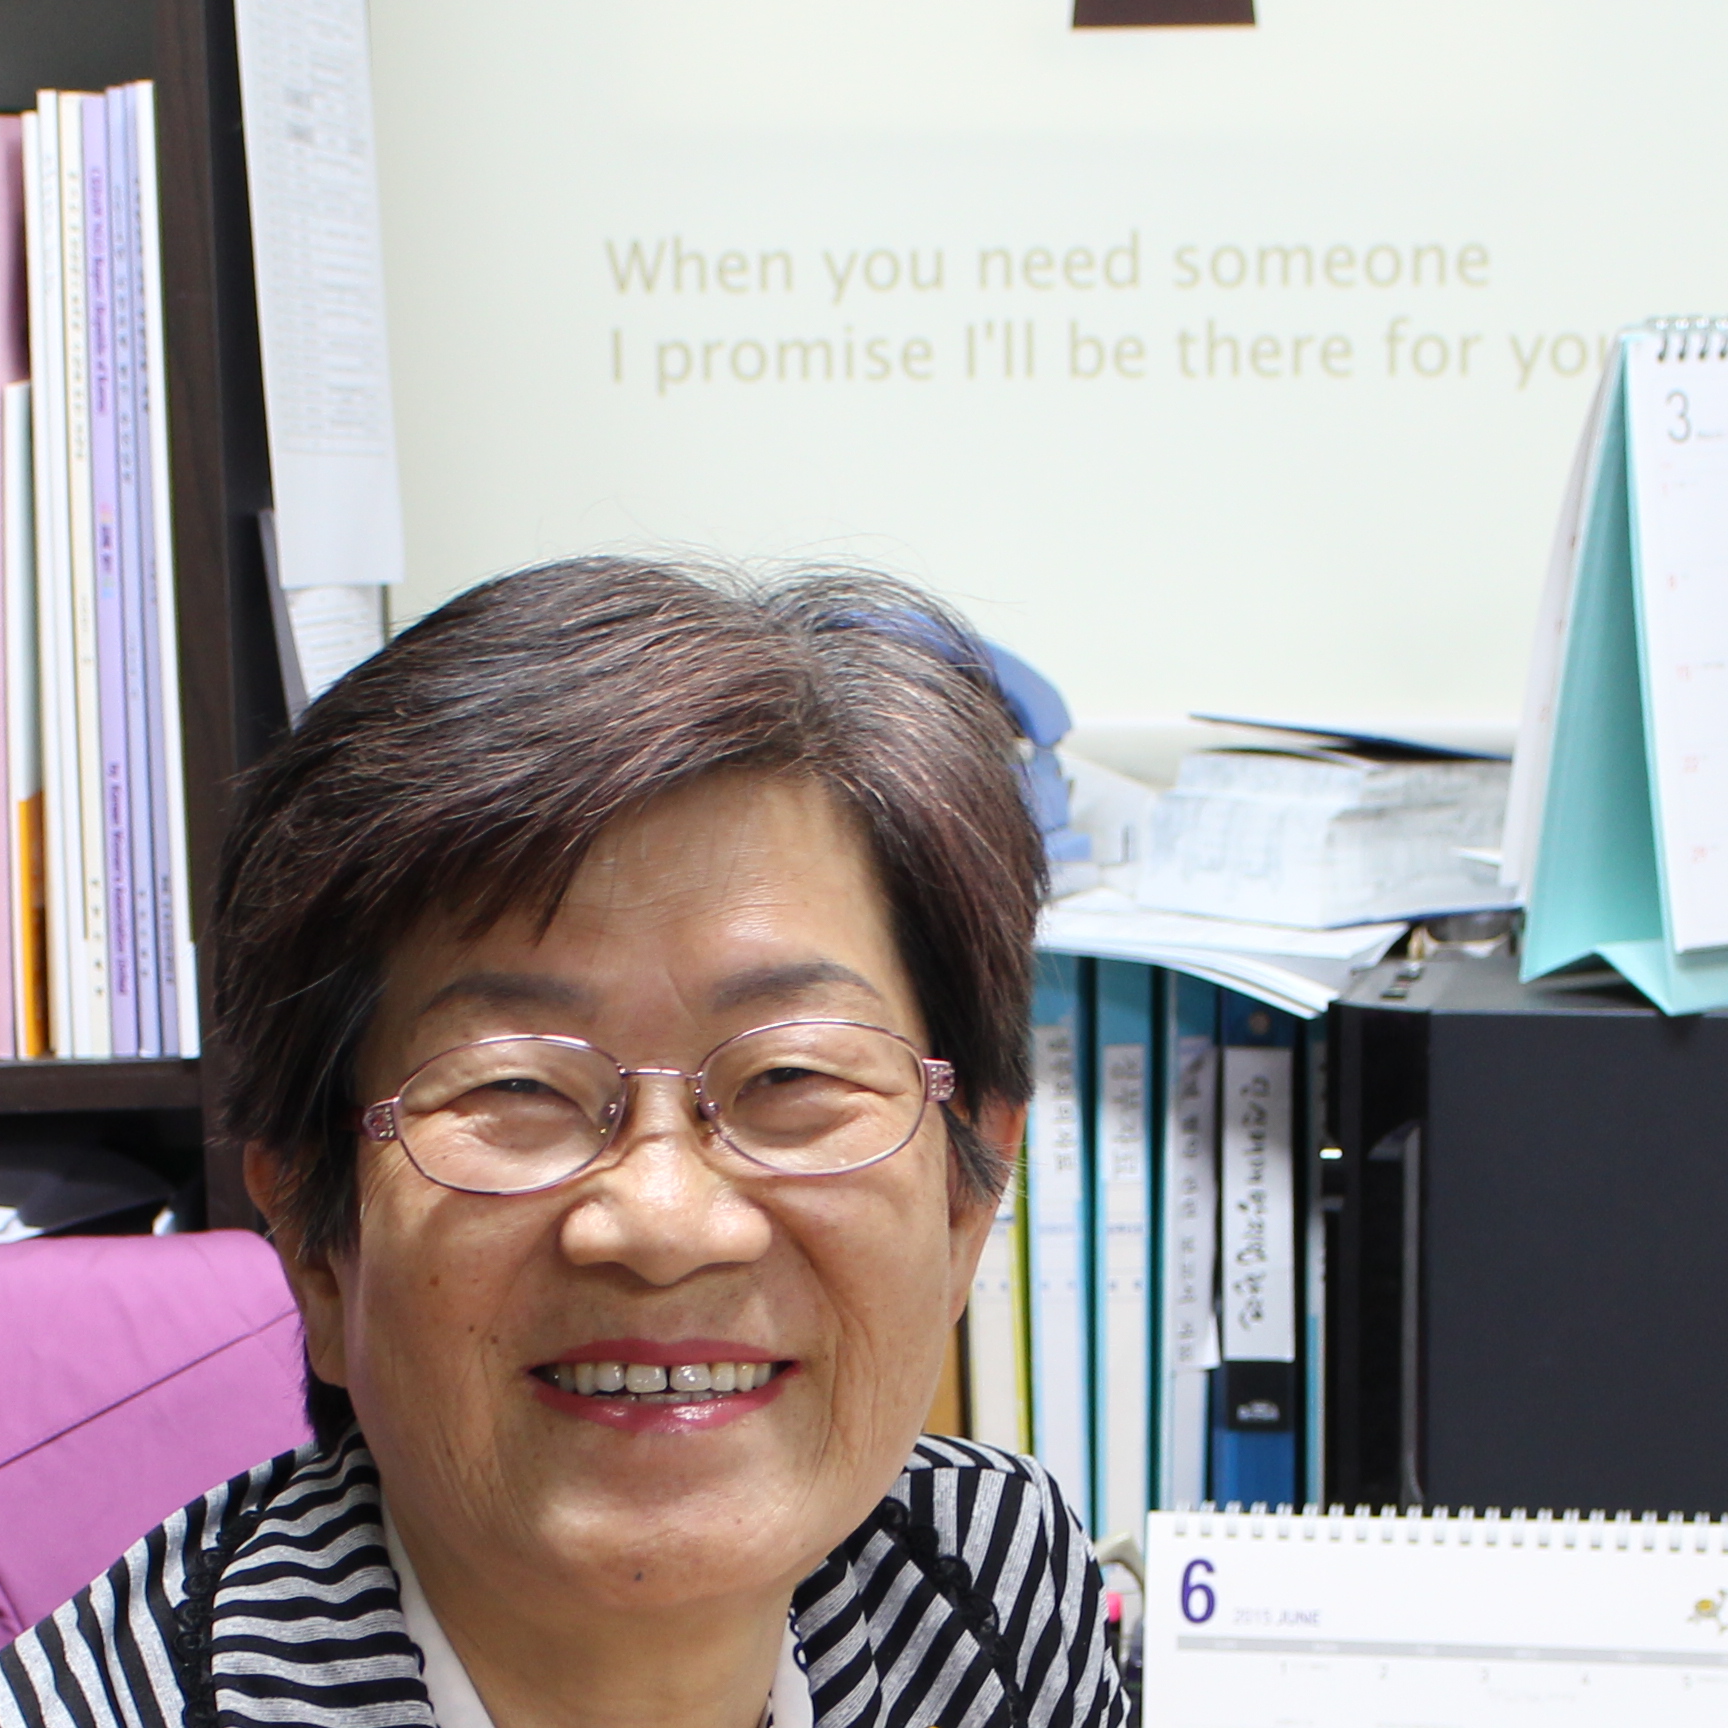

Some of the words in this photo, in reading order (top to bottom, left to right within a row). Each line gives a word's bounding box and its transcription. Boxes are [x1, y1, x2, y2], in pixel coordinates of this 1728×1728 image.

[604, 236, 794, 294] When
[825, 245, 944, 305] you
[977, 230, 1142, 290] need
[1173, 241, 1491, 290] someone
[609, 329, 623, 383] I
[656, 321, 935, 395] promise
[963, 321, 1037, 380] I'll
[1069, 319, 1146, 380] be
[1179, 319, 1354, 379] there
[1384, 315, 1482, 380] for
[1509, 333, 1608, 391] yo
[1665, 391, 1692, 443] 3
[1179, 1557, 1217, 1626] 6
[1276, 1608, 1321, 1627] JUNE
